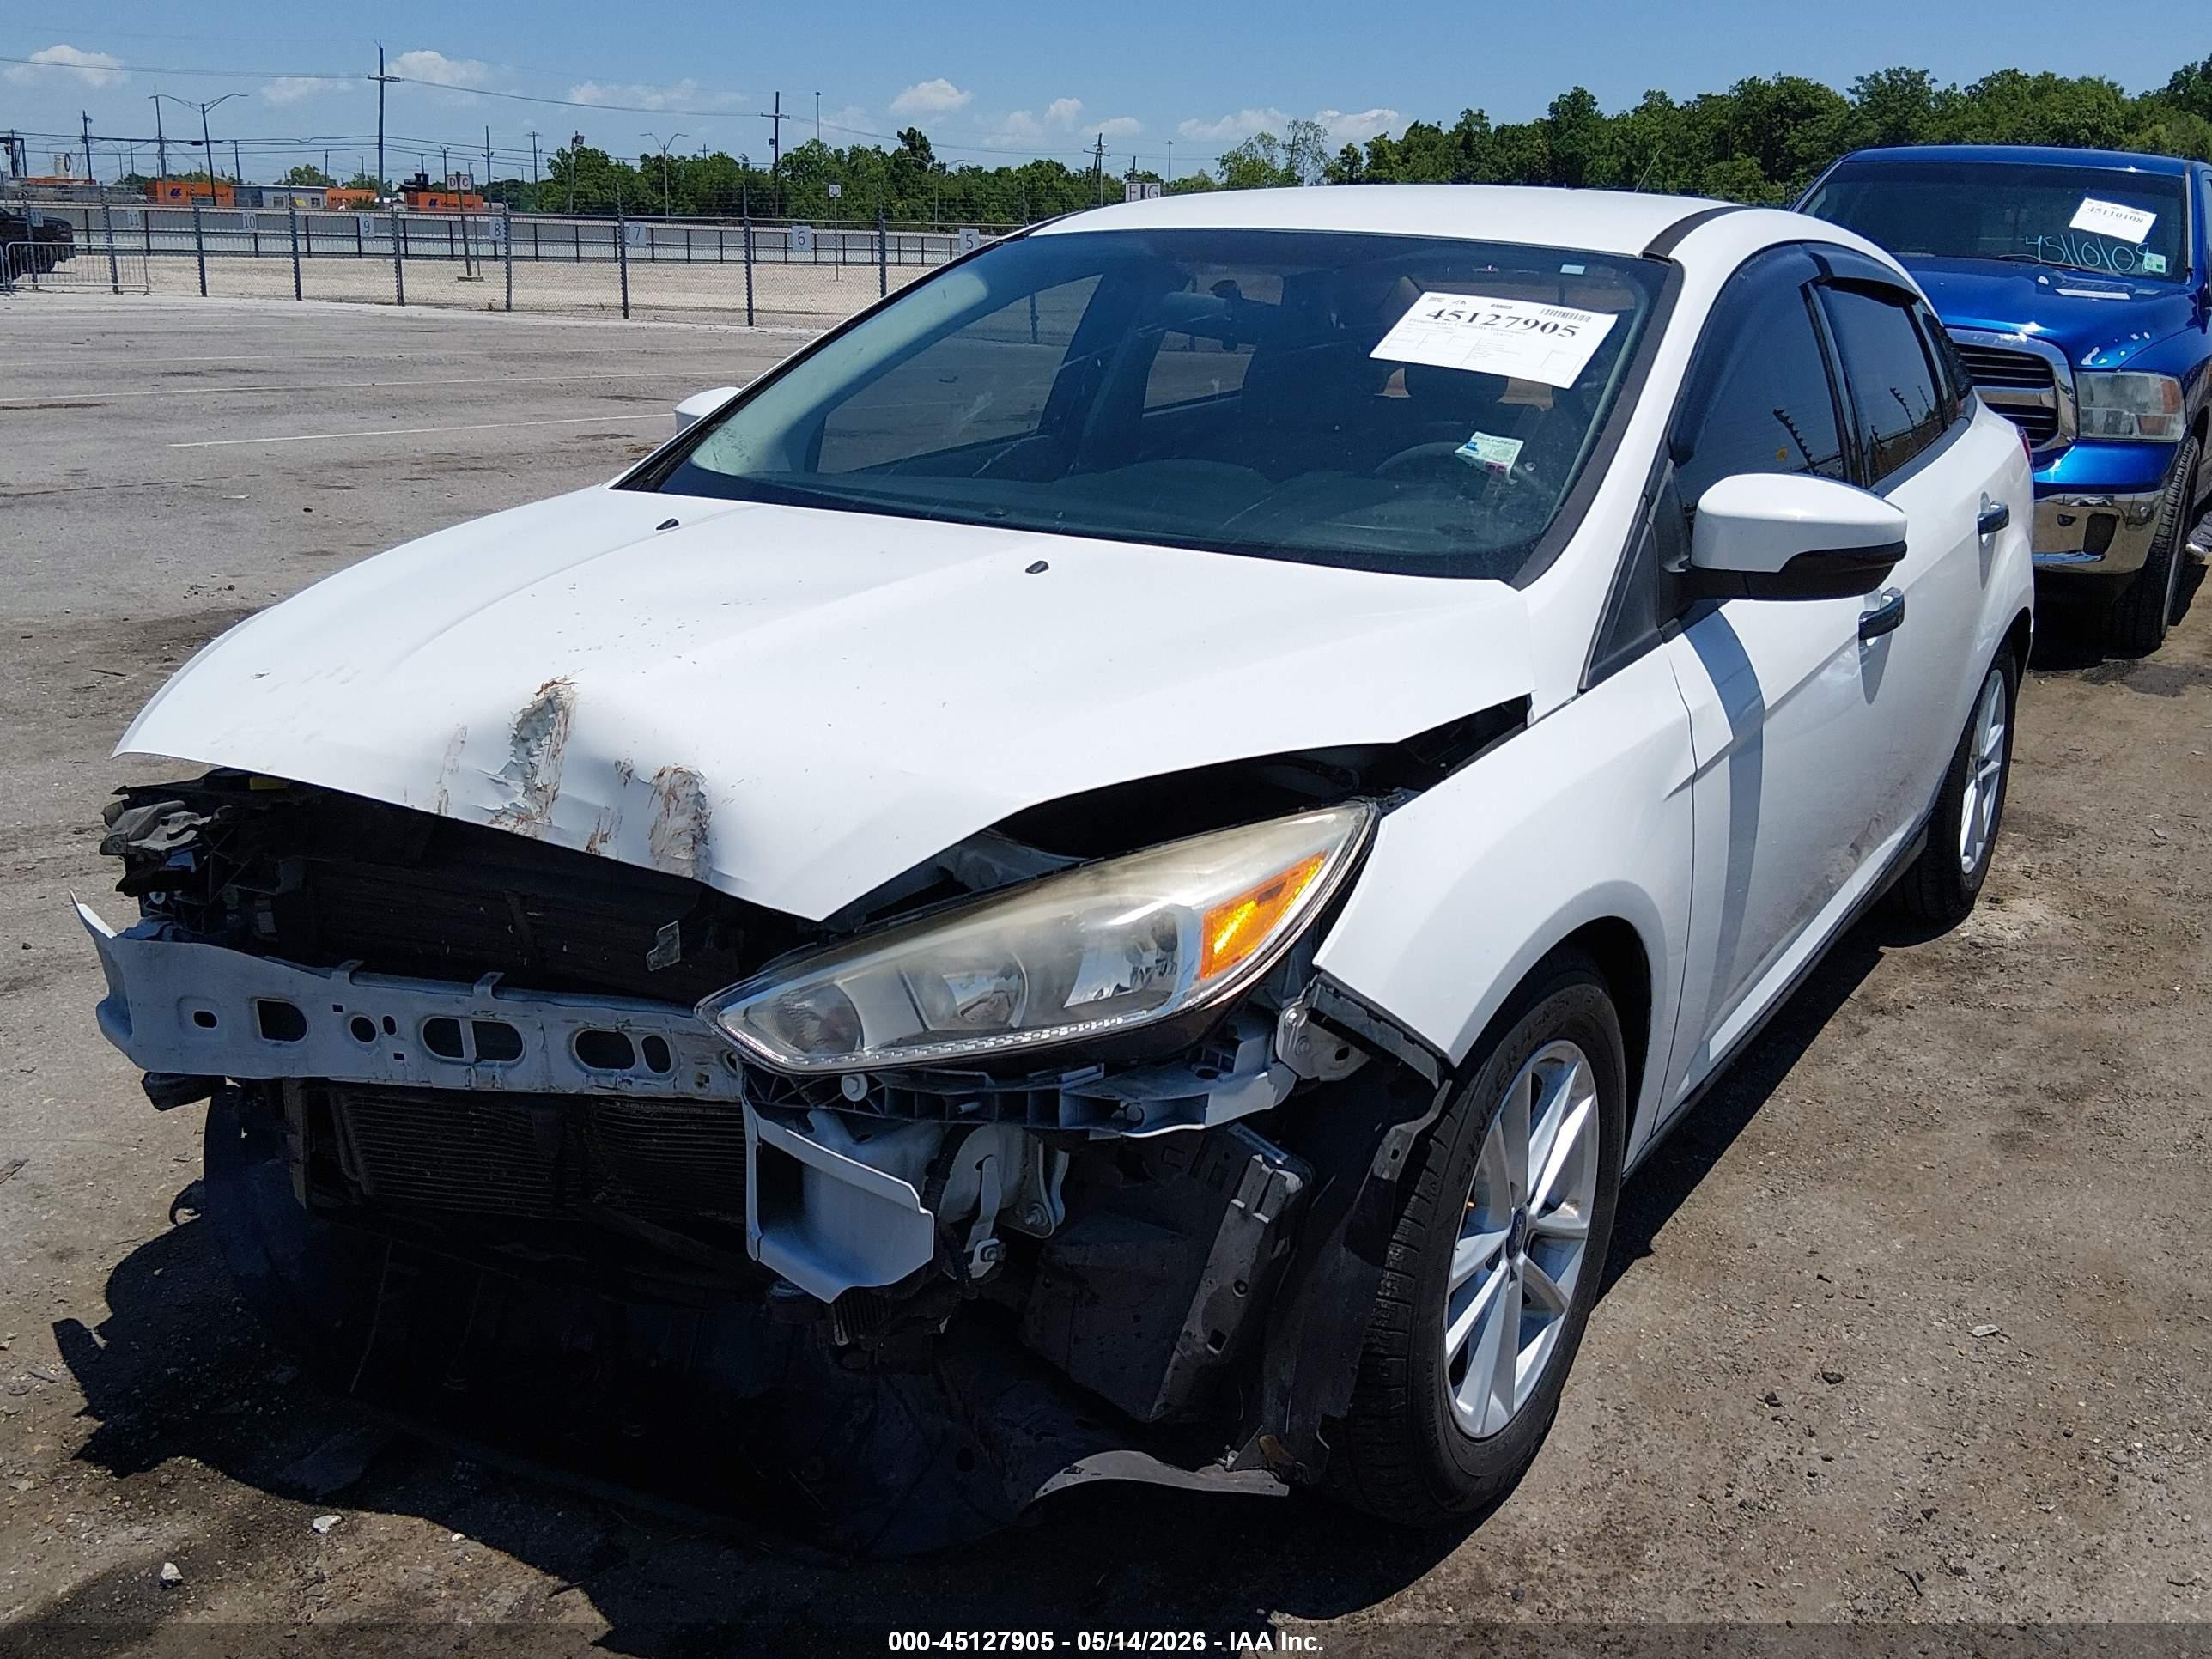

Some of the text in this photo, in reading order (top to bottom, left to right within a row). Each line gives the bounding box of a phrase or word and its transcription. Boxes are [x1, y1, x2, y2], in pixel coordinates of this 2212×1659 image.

[449, 177, 456, 187] D
[462, 177, 469, 187] C
[830, 186, 840, 196] 20
[1147, 184, 1158, 199] G
[2087, 206, 2144, 223] 45110108
[244, 216, 256, 228] 10
[363, 220, 370, 233] 9
[494, 222, 501, 236] 8
[634, 226, 641, 240] 7
[799, 231, 805, 246] 6
[965, 234, 974, 249] 5
[1425, 308, 1581, 338] 45127905
